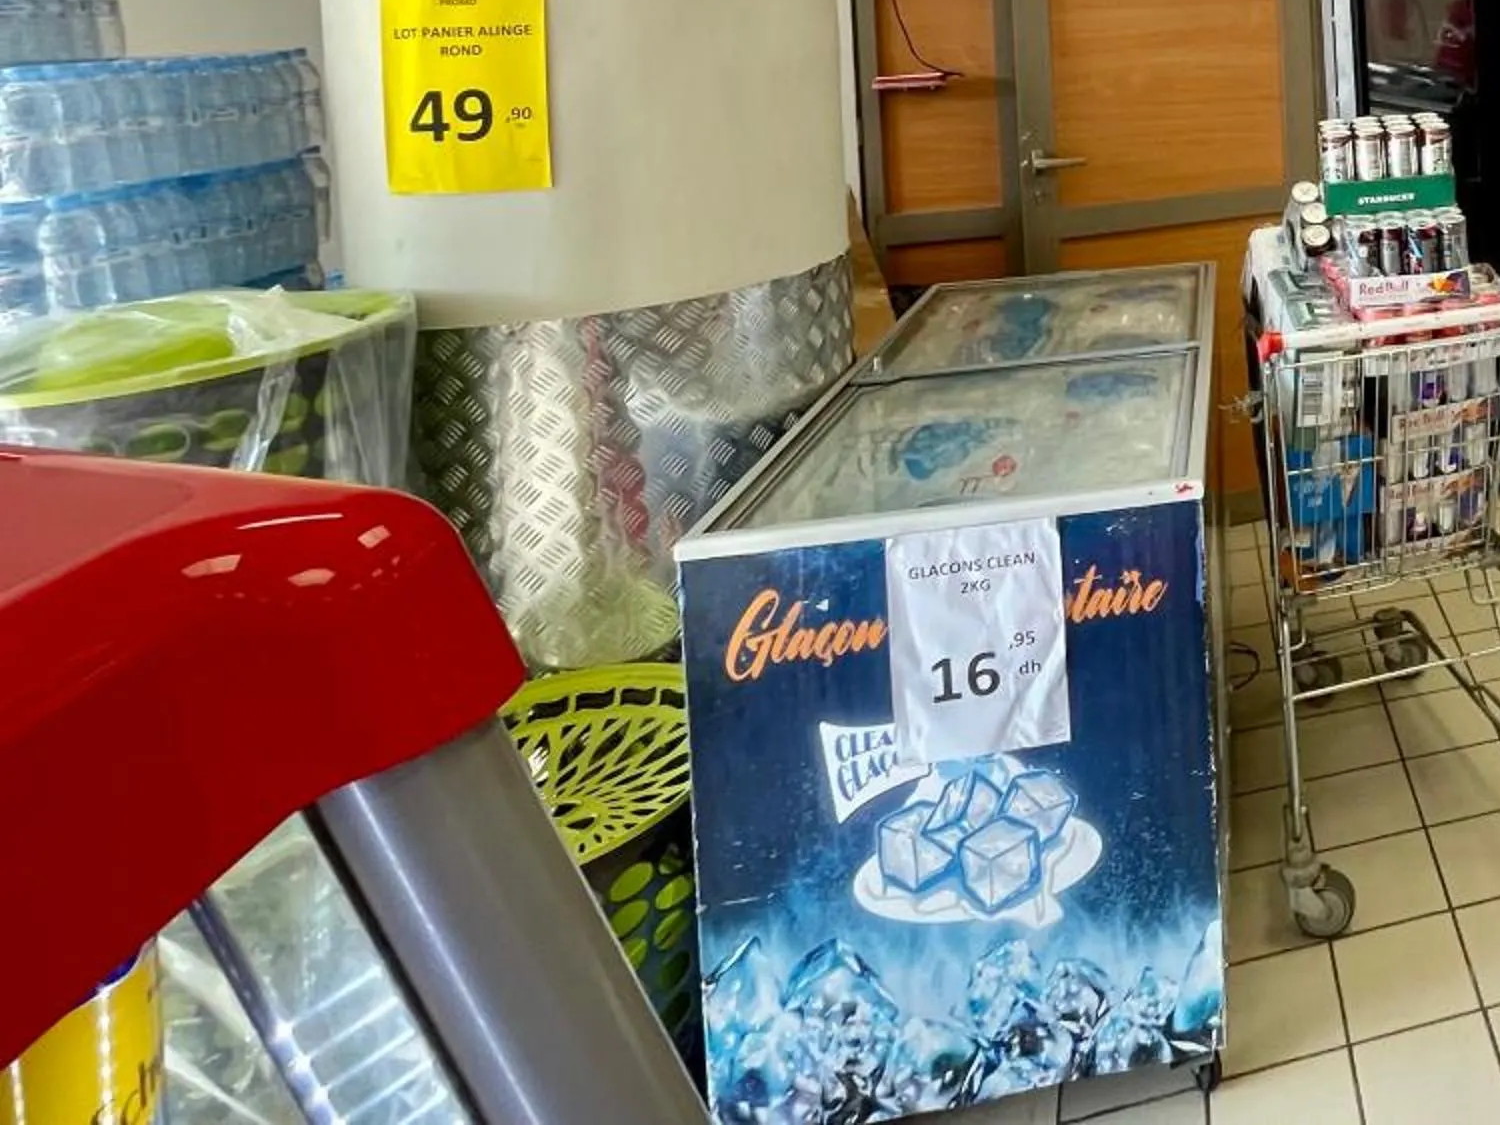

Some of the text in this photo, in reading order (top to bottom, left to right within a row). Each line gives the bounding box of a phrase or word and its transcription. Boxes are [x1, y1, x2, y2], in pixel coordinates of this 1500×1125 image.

[393, 24, 533, 40] LOT PANIER ALINGE
[440, 44, 483, 57] ROND
[409, 88, 493, 143] 49
[908, 551, 1036, 580] GLACONS CLEAN
[960, 578, 992, 594] 2KG
[930, 650, 1000, 704] 16
[1018, 660, 1042, 676] dh
[835, 730, 894, 763] CLEA
